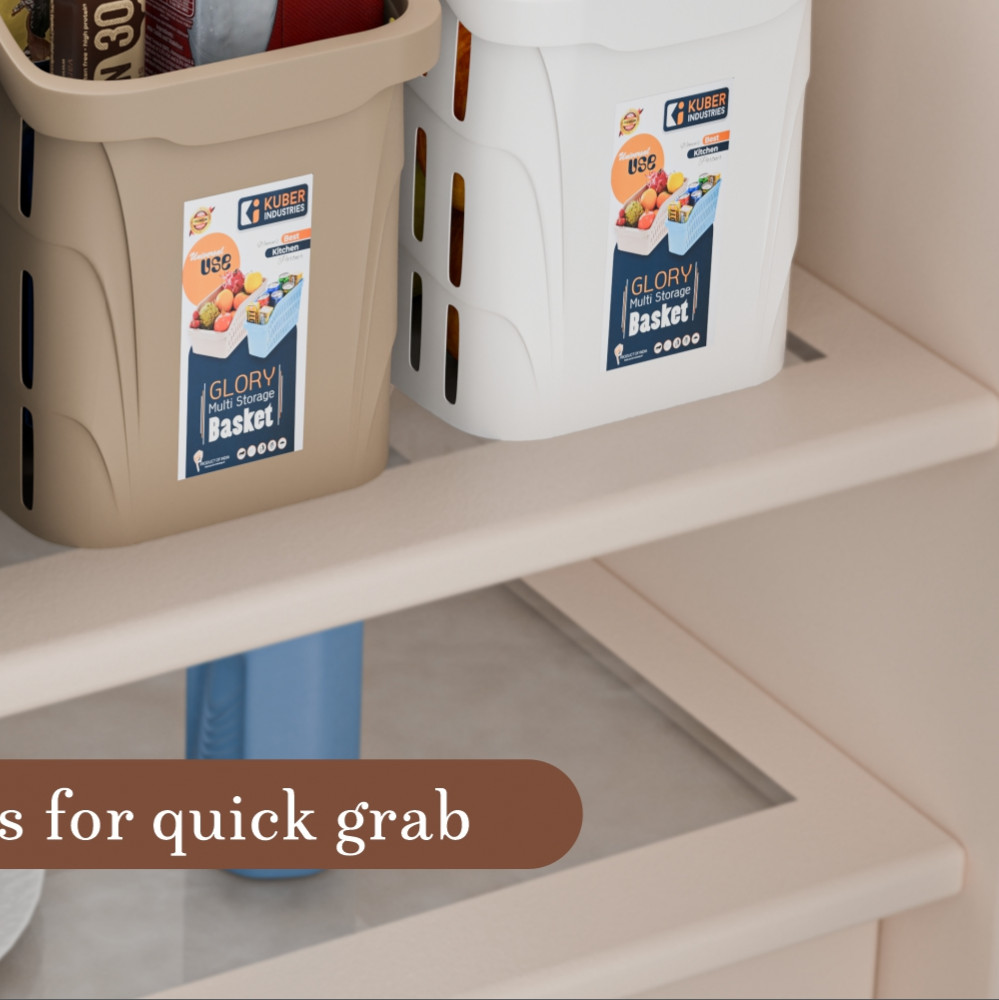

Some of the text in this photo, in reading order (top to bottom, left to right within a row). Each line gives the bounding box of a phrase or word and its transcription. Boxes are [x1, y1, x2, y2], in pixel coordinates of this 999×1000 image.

[688, 92, 726, 113] KUBER
[687, 106, 725, 122] INDUSTRIES
[693, 145, 719, 157] Kitchen
[264, 189, 305, 210] KUBER
[264, 203, 305, 220] INDUSTRIES
[272, 244, 299, 256] Kitchen
[631, 263, 693, 296] GLORY
[629, 285, 691, 309] Multi Storage
[629, 299, 689, 337] Basket
[209, 366, 276, 400] GLORY
[208, 389, 275, 414] Multi Storage
[208, 403, 274, 443] Basket
